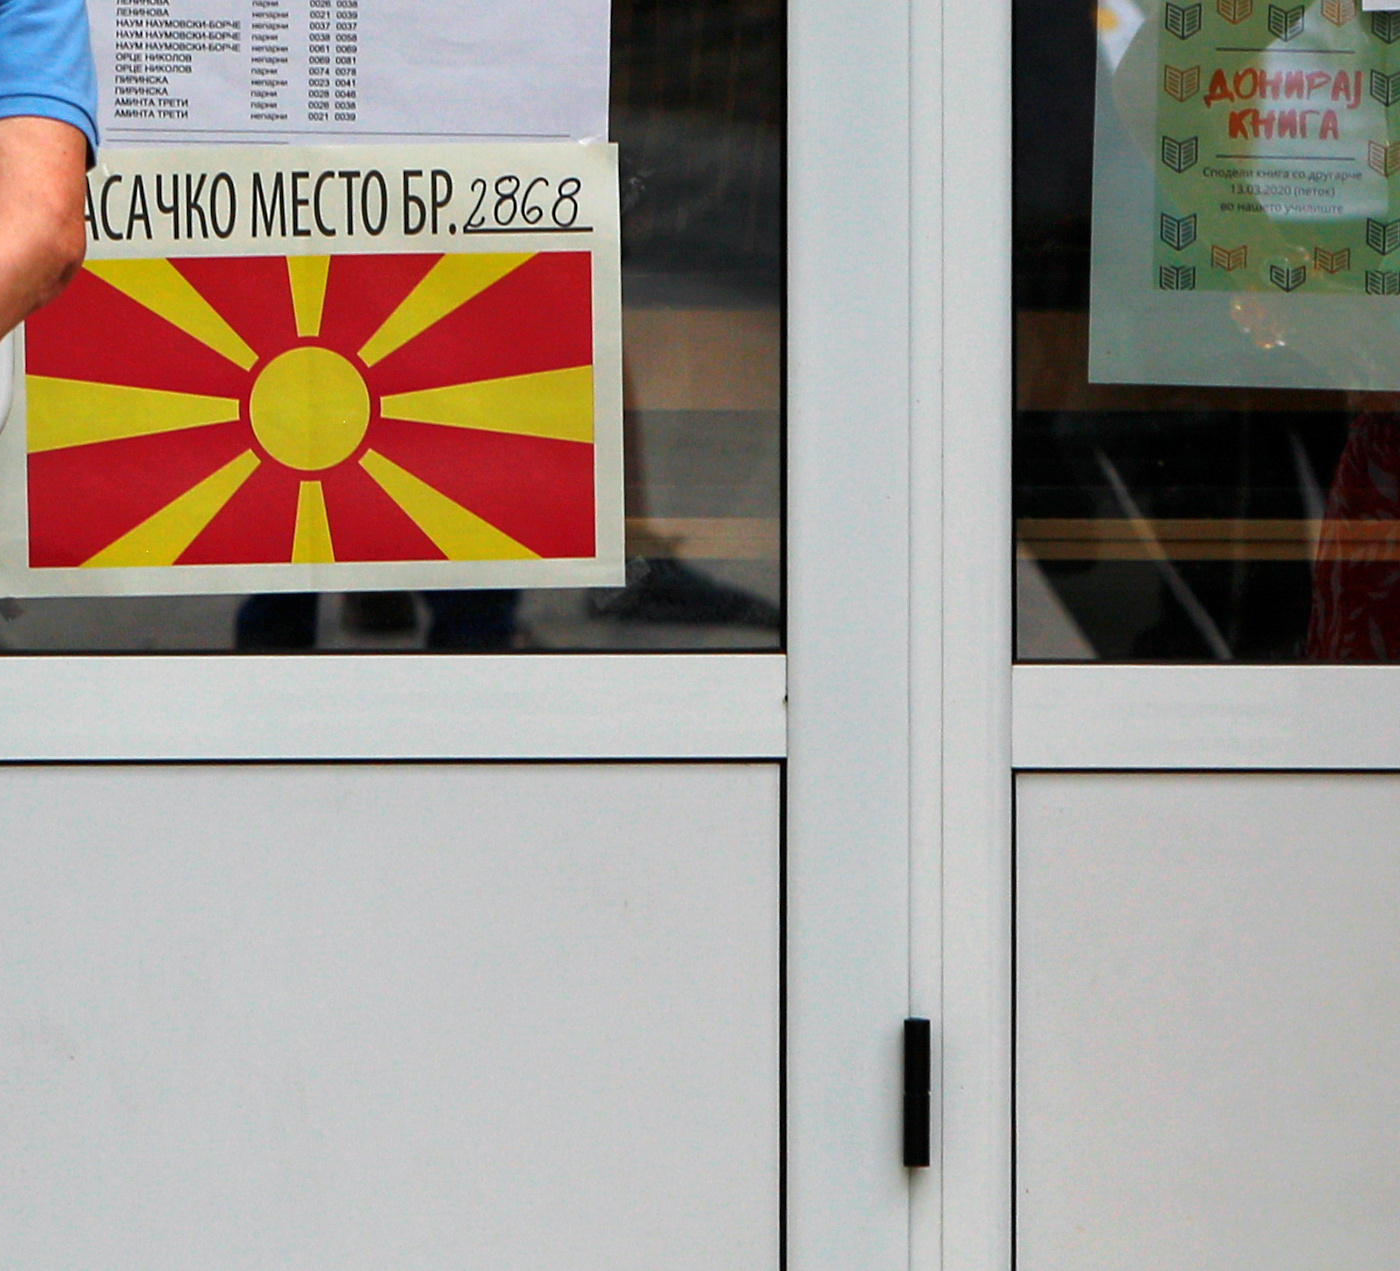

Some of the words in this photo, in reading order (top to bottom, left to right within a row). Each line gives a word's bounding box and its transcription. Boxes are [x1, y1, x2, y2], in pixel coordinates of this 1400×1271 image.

[116, 19, 143, 28] НАУМ
[145, 19, 240, 30] НАУМОВСКИ-БОРЧЕ
[115, 75, 168, 85] ПИРИНСКА
[1204, 68, 1363, 109] ДОНИРАЈ
[1228, 108, 1340, 140] КНИГА
[85, 169, 236, 242] АСАЧКО
[252, 170, 387, 237] МЕСТО
[403, 170, 456, 235] БР.
[465, 175, 581, 228] 2868
